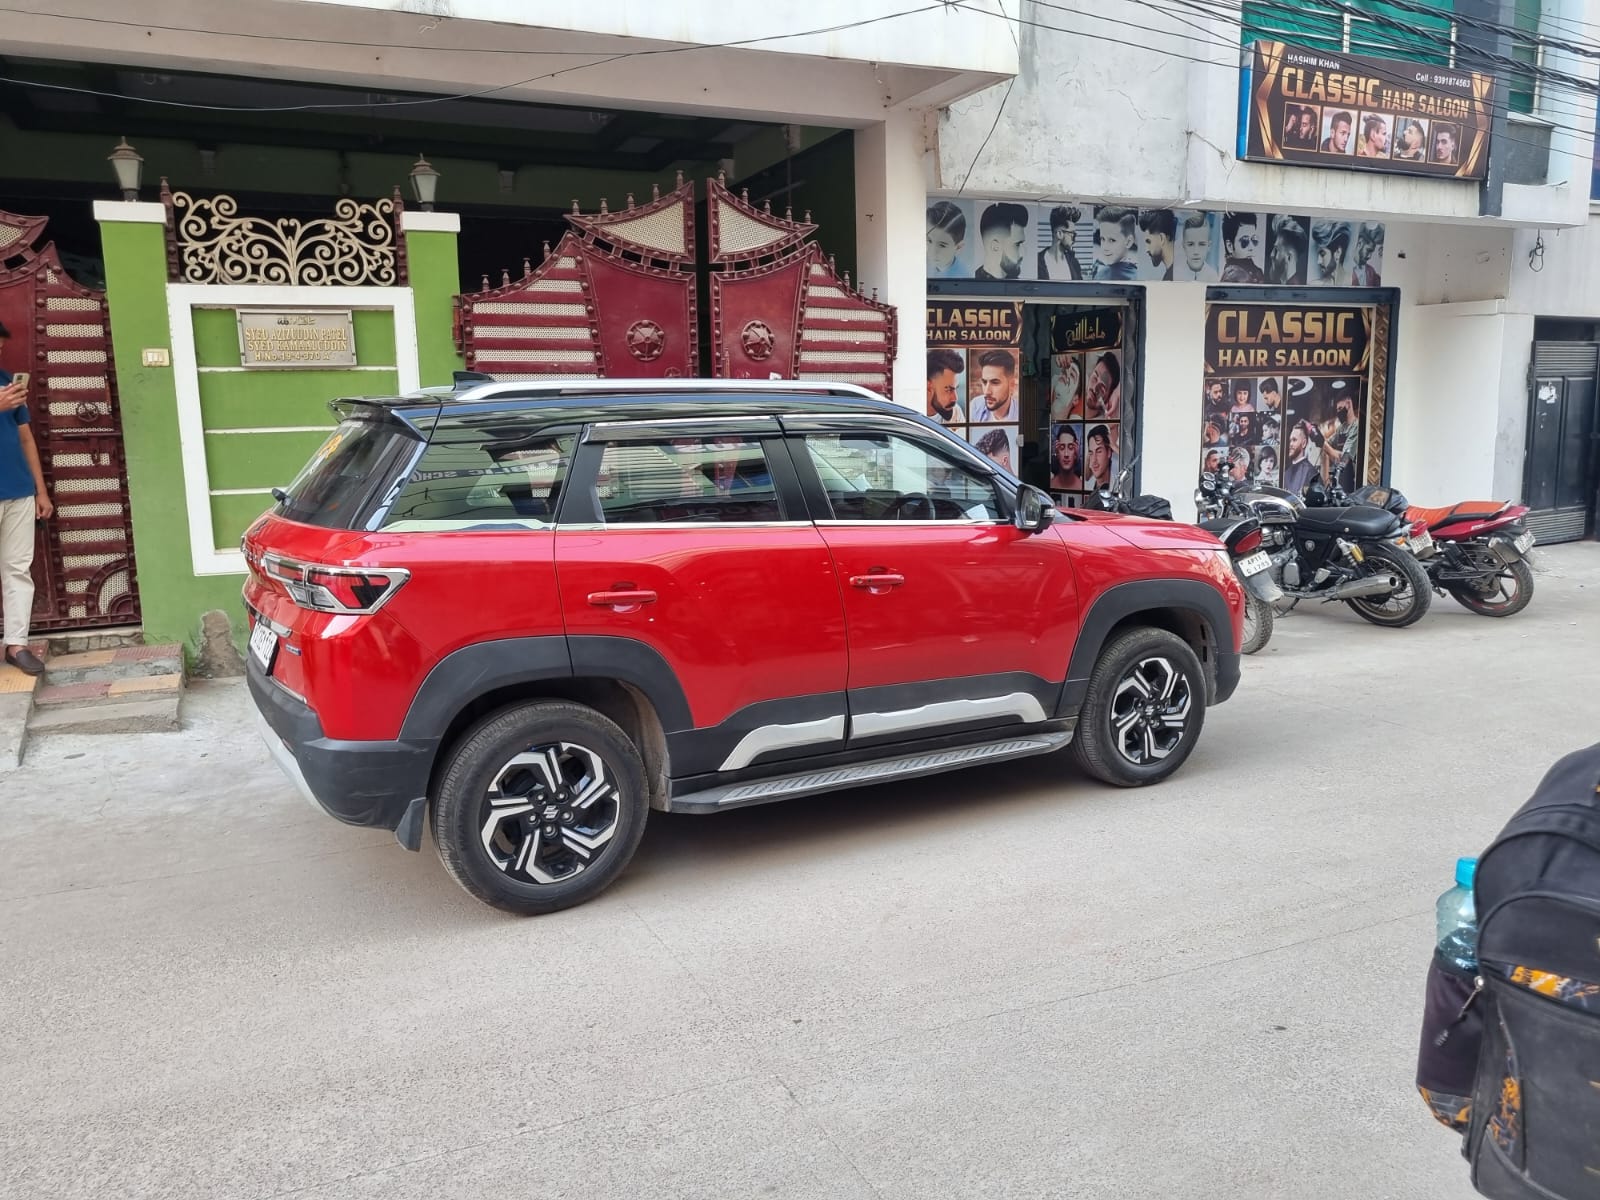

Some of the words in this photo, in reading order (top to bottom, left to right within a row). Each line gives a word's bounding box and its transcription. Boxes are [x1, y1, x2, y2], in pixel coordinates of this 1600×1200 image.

[1287, 54, 1318, 66] HASHIM
[1318, 58, 1341, 70] KHAN
[1281, 67, 1380, 108] CLASSIC
[1381, 89, 1415, 112] HAIR
[1419, 94, 1470, 119] SALOON
[245, 328, 268, 341] SYED
[1217, 310, 1354, 344] CLASSIC
[960, 330, 1011, 341] SALOON
[248, 340, 274, 352] SYED
[1218, 349, 1269, 367] HAIR
[1274, 349, 1351, 367] SALOON
